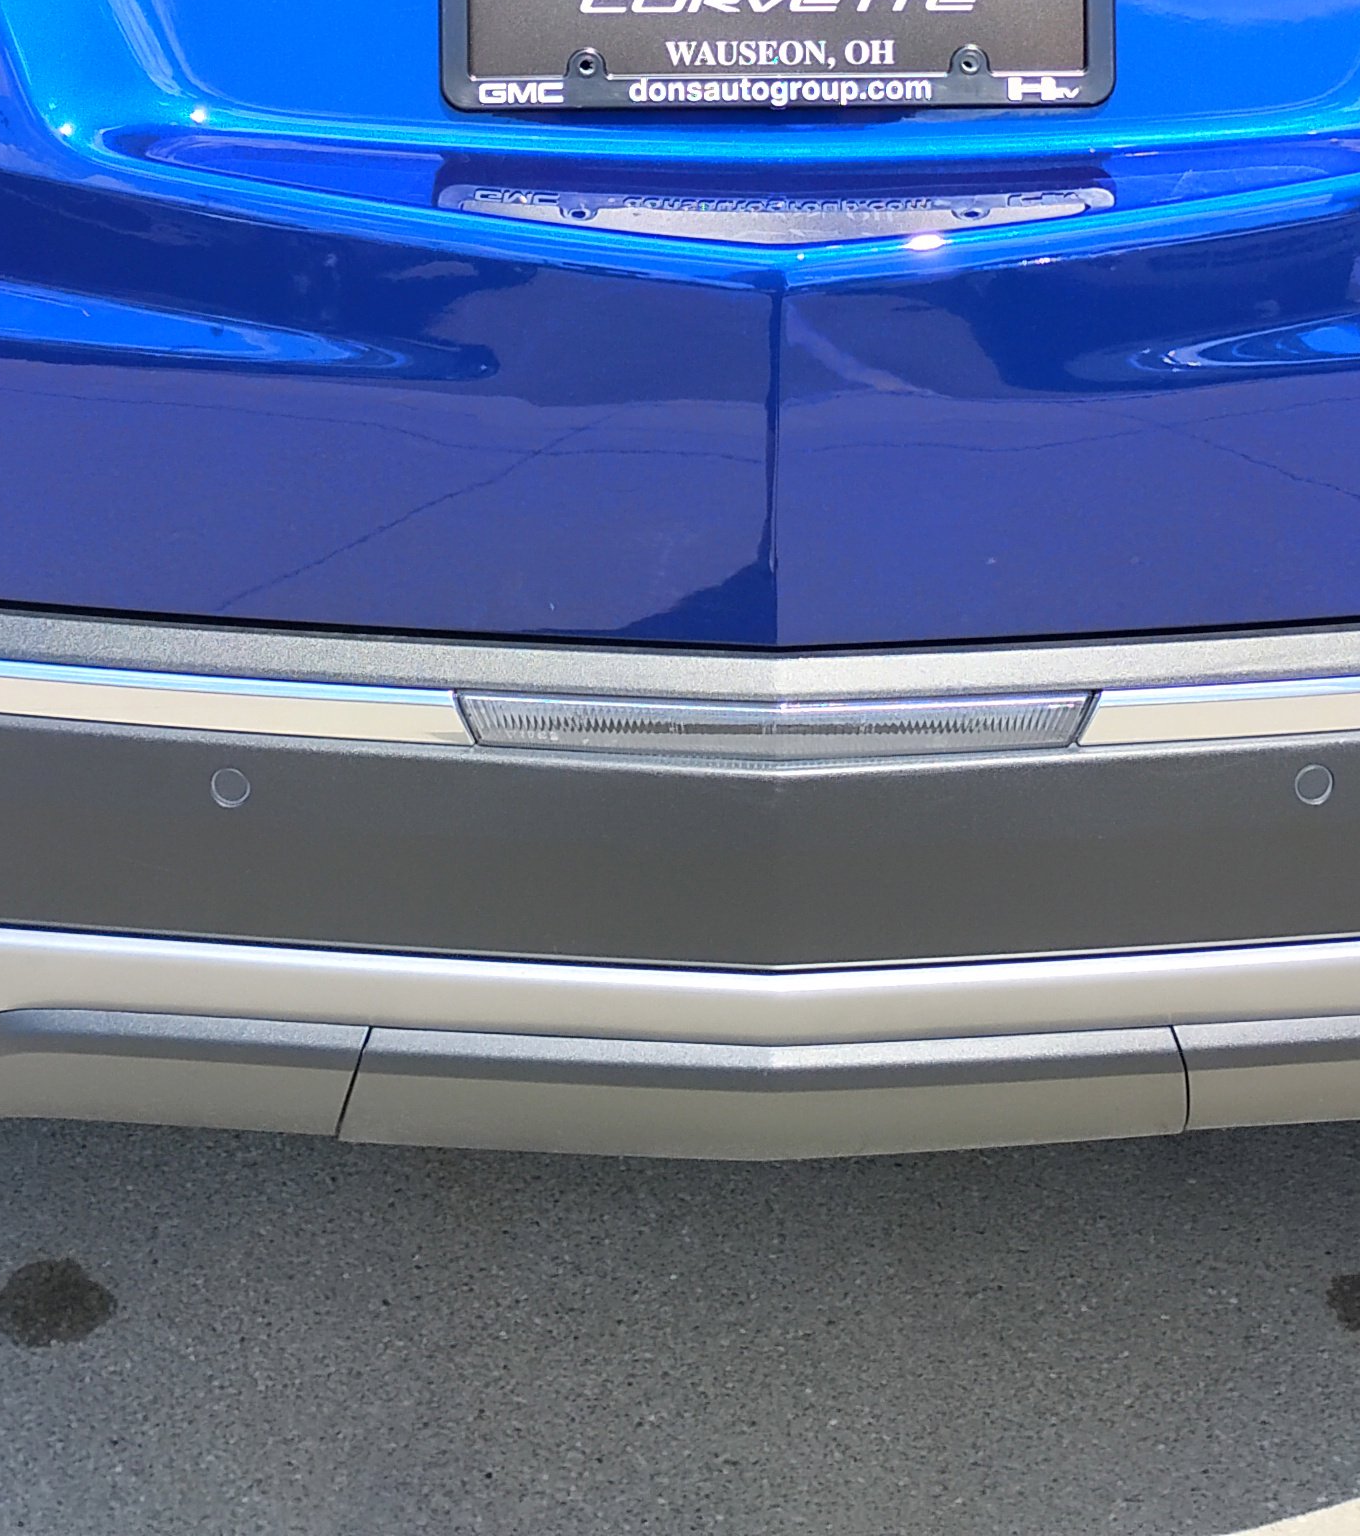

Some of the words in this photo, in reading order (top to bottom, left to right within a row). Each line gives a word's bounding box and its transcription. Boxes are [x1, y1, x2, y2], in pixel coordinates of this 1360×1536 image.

[665, 40, 836, 69] WAUSEON,
[844, 40, 895, 66] OH
[478, 82, 564, 104] GMC
[628, 78, 932, 106] donsautogroup.com
